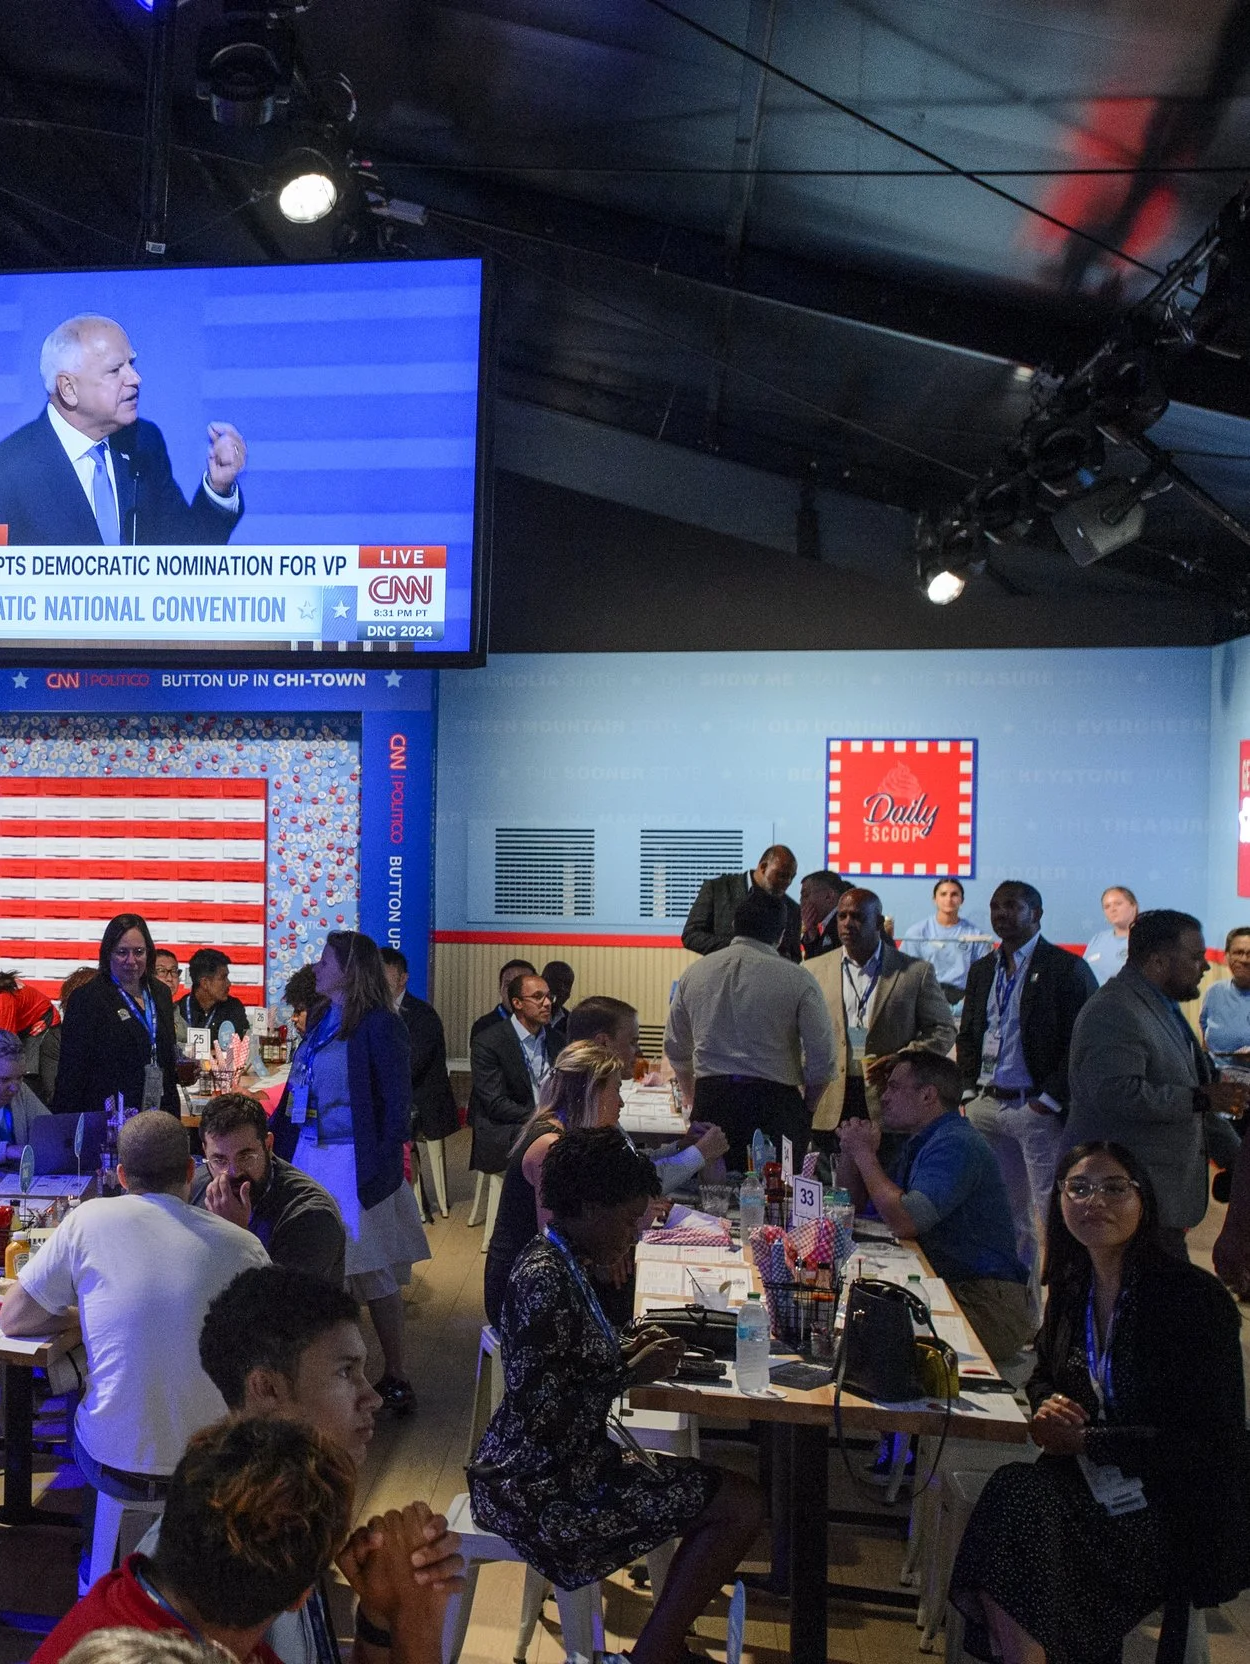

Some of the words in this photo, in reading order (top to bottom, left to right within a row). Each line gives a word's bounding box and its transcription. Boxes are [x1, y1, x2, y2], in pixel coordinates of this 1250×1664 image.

[32, 555, 150, 576] DEMOCRATIC
[156, 555, 273, 576] NOMINATION
[280, 555, 317, 576] FOR
[323, 556, 347, 575] VP
[380, 549, 424, 564] LIVE
[368, 575, 433, 605] CNN
[44, 596, 146, 621] NATIONAL
[152, 596, 286, 622] CONVENTION
[373, 609, 394, 617] 8:31
[397, 609, 413, 617] PM
[415, 609, 428, 617] PT
[367, 626, 397, 637] DNC
[400, 626, 433, 637] 2024
[46, 672, 80, 689] CNN
[90, 674, 150, 687] POLITICO
[161, 674, 223, 688] BUTTON
[228, 674, 248, 688] UP
[253, 674, 269, 688] IN
[273, 673, 367, 688] CHI-TOWN
[389, 734, 407, 770] CNN
[390, 781, 404, 845] POLITICO
[863, 792, 940, 839] Daily
[871, 826, 921, 843] SCOOP
[388, 856, 403, 923] BUTTON
[387, 927, 401, 950] UP
[257, 1012, 265, 1023] 26
[193, 1033, 205, 1045] 25
[799, 1188, 815, 1207] 33
